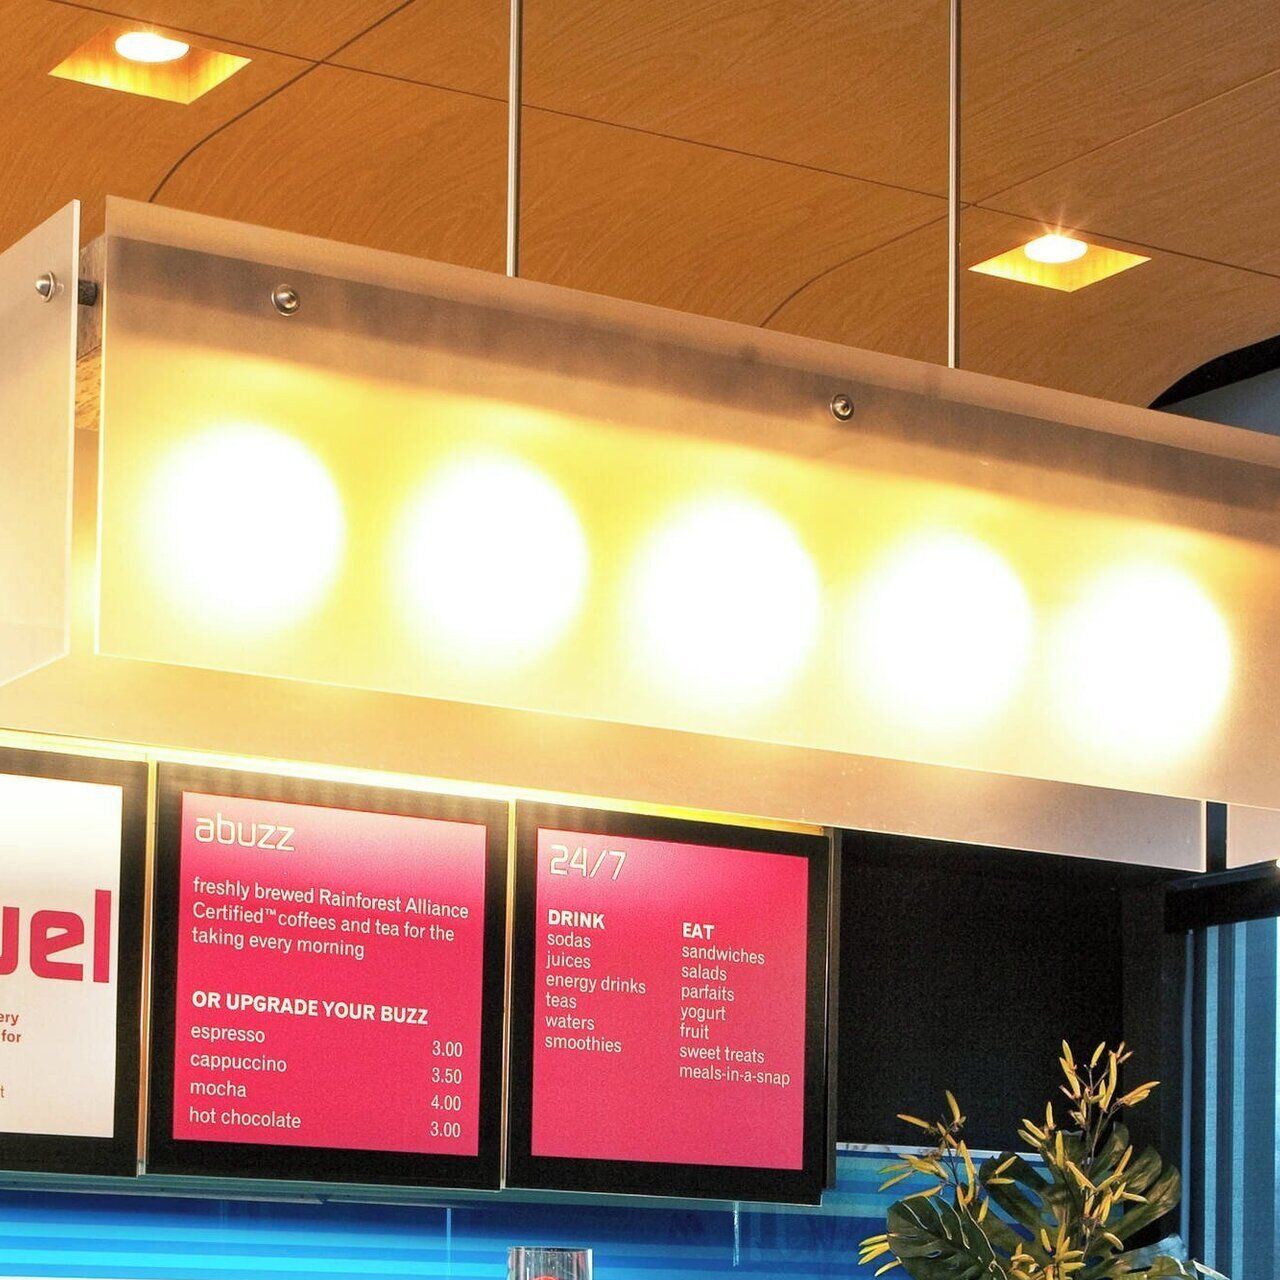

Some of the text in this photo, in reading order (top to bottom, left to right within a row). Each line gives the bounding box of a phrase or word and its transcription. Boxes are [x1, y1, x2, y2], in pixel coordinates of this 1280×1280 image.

[194, 812, 295, 851] abuzz
[549, 844, 627, 880] 24/7
[192, 875, 469, 919] freshly brewed Rainforest Alliance
[277, 911, 337, 931] coffees
[340, 917, 371, 934] and
[374, 919, 400, 937] tea
[403, 921, 426, 939] for
[429, 924, 455, 942] the
[548, 908, 605, 930] DRINK
[547, 931, 592, 949] sodas
[682, 922, 715, 940] EAT
[191, 926, 365, 961] taking every morning
[545, 951, 592, 970] juices
[681, 944, 765, 965] sandwiches
[681, 963, 727, 982] salads
[545, 974, 646, 994] energy drinks
[681, 983, 735, 1002] parfaits
[191, 990, 429, 1025] OR UPGRADE YOUR BUZZ
[545, 991, 577, 1009] teas
[545, 1013, 595, 1031] waters
[680, 1005, 727, 1023] yogurt
[1, 1028, 22, 1043] for
[679, 1022, 710, 1040] fruit
[190, 1025, 463, 1058] espresso 3.00
[544, 1035, 622, 1053] smoothies
[679, 1045, 765, 1064] sweet treats
[190, 1053, 463, 1085] cappuccino 3.50
[679, 1064, 791, 1089] meals-in-a-snap
[190, 1079, 462, 1112] mocha 4.00
[189, 1105, 461, 1138] hot chocolate 3.00
